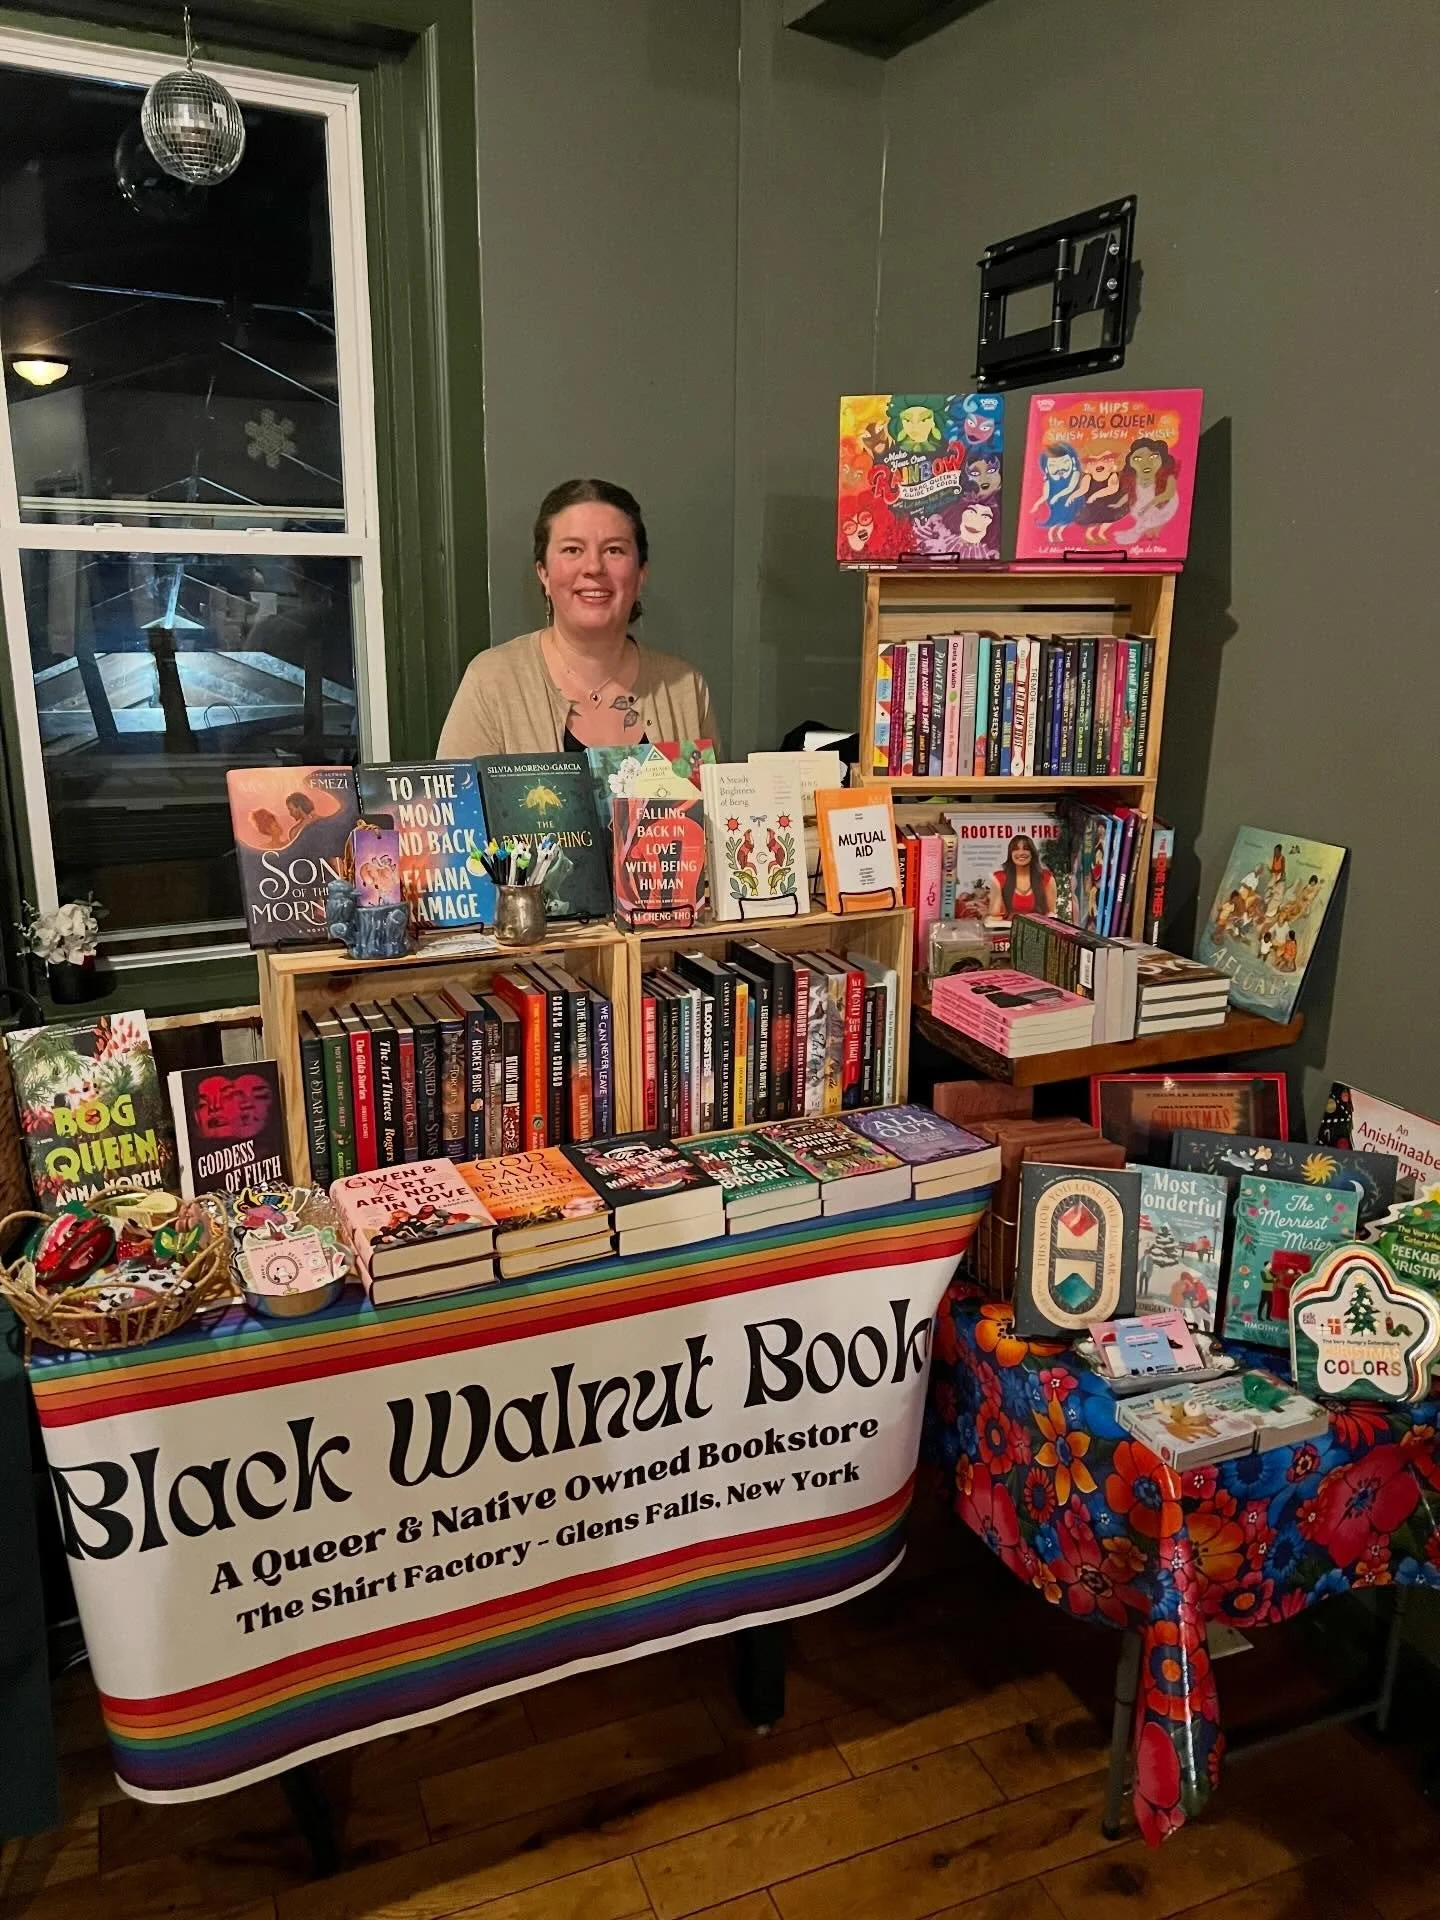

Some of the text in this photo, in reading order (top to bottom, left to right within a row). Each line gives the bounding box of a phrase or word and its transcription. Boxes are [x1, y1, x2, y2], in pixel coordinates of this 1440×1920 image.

[1100, 402, 1129, 413] HIPS
[1069, 414, 1155, 429] DRAG QUEEN
[867, 442, 965, 505] RAINBOW
[907, 653, 916, 700] CROSS-STITCH
[933, 650, 946, 718] PRIVATE RITES
[1030, 668, 1038, 702] TREMOR
[1142, 671, 1150, 694] MAKING
[991, 659, 1002, 737] KINGDOM SWEETS
[1016, 705, 1025, 726] DREAM
[1140, 712, 1148, 728] WITH
[1137, 740, 1145, 757] LAND
[487, 763, 582, 774] SILVIA MORENO-GARCIA
[310, 778, 348, 790] EMEZI
[386, 773, 458, 801] TO THE
[726, 776, 749, 784] Steady
[720, 787, 756, 796] Brightness
[636, 807, 686, 820] FALLING
[729, 799, 749, 807] Being
[399, 803, 455, 828] MOON
[536, 820, 555, 828] THE
[399, 828, 475, 856] ND BACK
[637, 826, 685, 838] BACK IN
[839, 830, 886, 846] MUTUAL
[961, 825, 1013, 839] ROOTED
[1031, 825, 1060, 839] FIRE
[646, 843, 677, 855] LOVE
[856, 845, 873, 858] AID
[259, 850, 342, 900] SON
[625, 860, 697, 873] WITH BEING
[292, 888, 306, 897] OF
[640, 879, 684, 891] HUMAN
[1153, 886, 1166, 918] THIEF
[252, 901, 328, 926] MORN
[601, 1006, 609, 1020] WE
[796, 977, 807, 1037] THE DAWNHOUNDS
[704, 1003, 712, 1037] BLOOD
[760, 1005, 768, 1039] LEGENDARY
[552, 996, 563, 1087] CASTLE CURSED
[576, 997, 588, 1077] TO THE MOON AND BACK
[421, 1038, 436, 1096] TARNISHED
[472, 1039, 482, 1093] HOCKEY BOIS
[601, 1043, 609, 1070] NEVER
[760, 1041, 768, 1071] FRYBREAD
[356, 1055, 368, 1100] Gilda Stories
[380, 1041, 393, 1121] The Art Thieves
[599, 1071, 607, 1095] LEAVE
[51, 1094, 136, 1137] BOG
[309, 1060, 326, 1155] MY DEAR HENRY
[1152, 1109, 1231, 1128] CHRISTMAS
[872, 1115, 930, 1130] ALL
[879, 1121, 937, 1138] OUT
[1396, 1124, 1409, 1136] An
[383, 1128, 395, 1162] Rogers
[793, 1133, 849, 1149] WHISTLE
[794, 1131, 835, 1143] NEVER
[1357, 1121, 1440, 1170] Anishinaabe
[45, 1129, 159, 1183] QUEEN
[198, 1140, 255, 1178] GODDESS
[699, 1147, 755, 1163] MAKE
[813, 1144, 852, 1156] NIGHT
[475, 1153, 544, 1170] GOD
[482, 1162, 552, 1182] SAVE
[595, 1147, 679, 1176] MONSTERS
[707, 1158, 783, 1180] SEASON
[224, 1155, 282, 1193] OF FILTH
[345, 1169, 417, 1188] GWEN
[475, 1169, 573, 1193] BENEDICT
[605, 1160, 694, 1190] MAINFRAMES
[719, 1167, 790, 1189] BRIGHT
[1152, 1173, 1198, 1195] Most
[55, 1168, 162, 1208] ANNA NORTH
[357, 1183, 446, 1208] ARE NOT
[377, 1178, 427, 1195] ART
[489, 1177, 571, 1198] ARNOLD
[385, 1201, 407, 1211] IN
[415, 1187, 469, 1205] LOVE
[1286, 1195, 1315, 1211] The
[1258, 1208, 1330, 1230] Merriest
[1282, 1231, 1335, 1251] Mister
[1392, 1258, 1440, 1280] HRISTM
[1244, 1320, 1280, 1333] TIMOTHY
[1324, 1360, 1401, 1376] COLORS
[48, 1417, 352, 1560] Black
[386, 1334, 714, 1486] Walnut
[210, 1418, 879, 1594] A Queer & Native Owned Bookstore
[236, 1598, 304, 1635] The
[311, 1572, 397, 1613] Shirt
[404, 1540, 532, 1588] Factory
[556, 1512, 640, 1547] Glens
[727, 1478, 785, 1505] New
[792, 1461, 860, 1492] York
